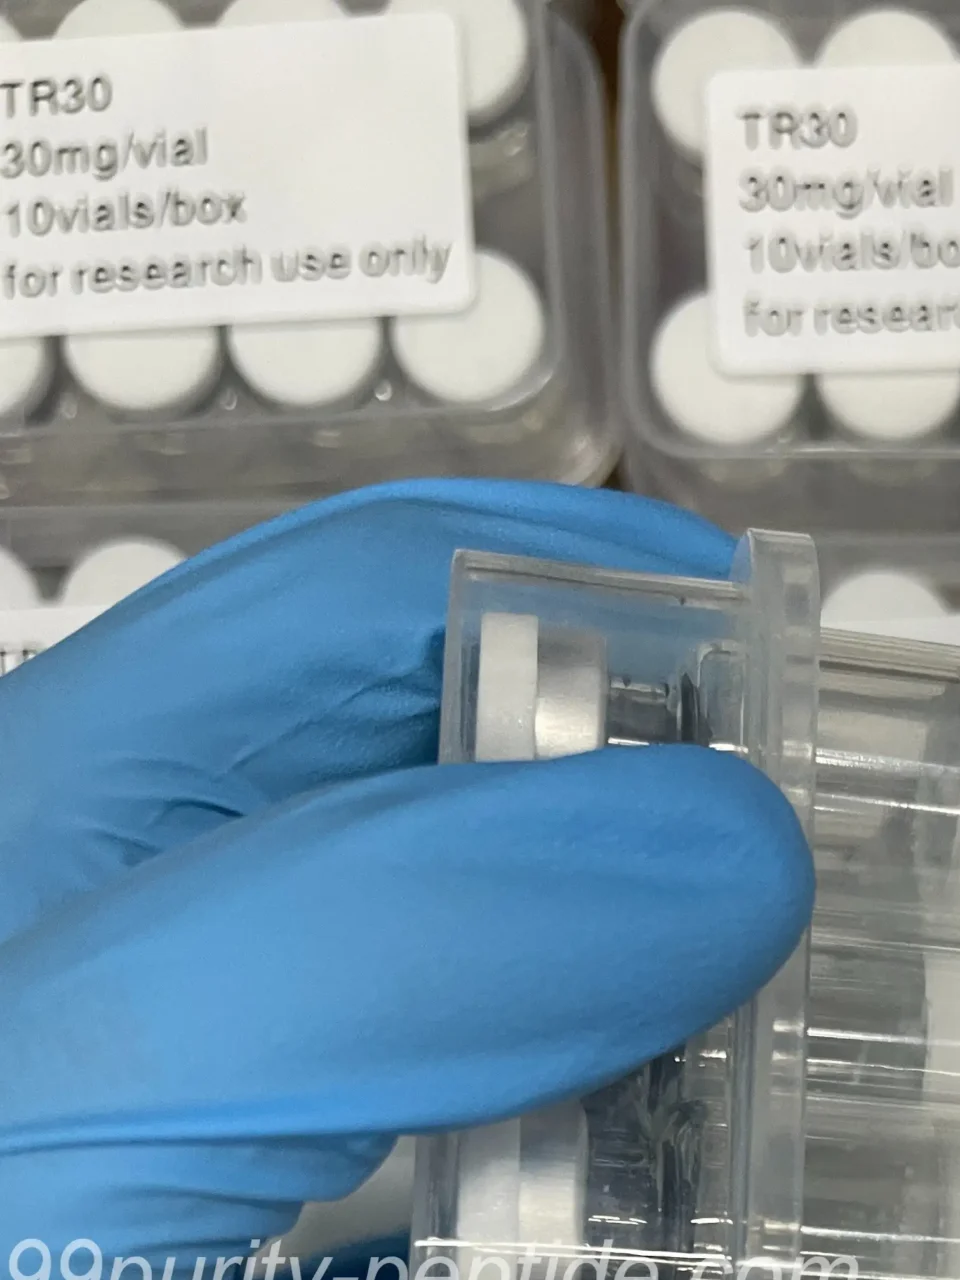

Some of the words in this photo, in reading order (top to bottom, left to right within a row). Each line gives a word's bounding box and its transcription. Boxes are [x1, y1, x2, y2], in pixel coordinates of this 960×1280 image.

[0, 73, 113, 118] TR30
[735, 105, 858, 151] TR30
[0, 127, 208, 181] 30mg/vial
[5, 187, 247, 238] 10vials/box
[738, 166, 955, 218] 30mg/vial
[2, 258, 61, 299] for
[71, 246, 262, 295] research
[273, 244, 351, 283] use
[365, 235, 452, 284] only
[743, 293, 804, 338] for
